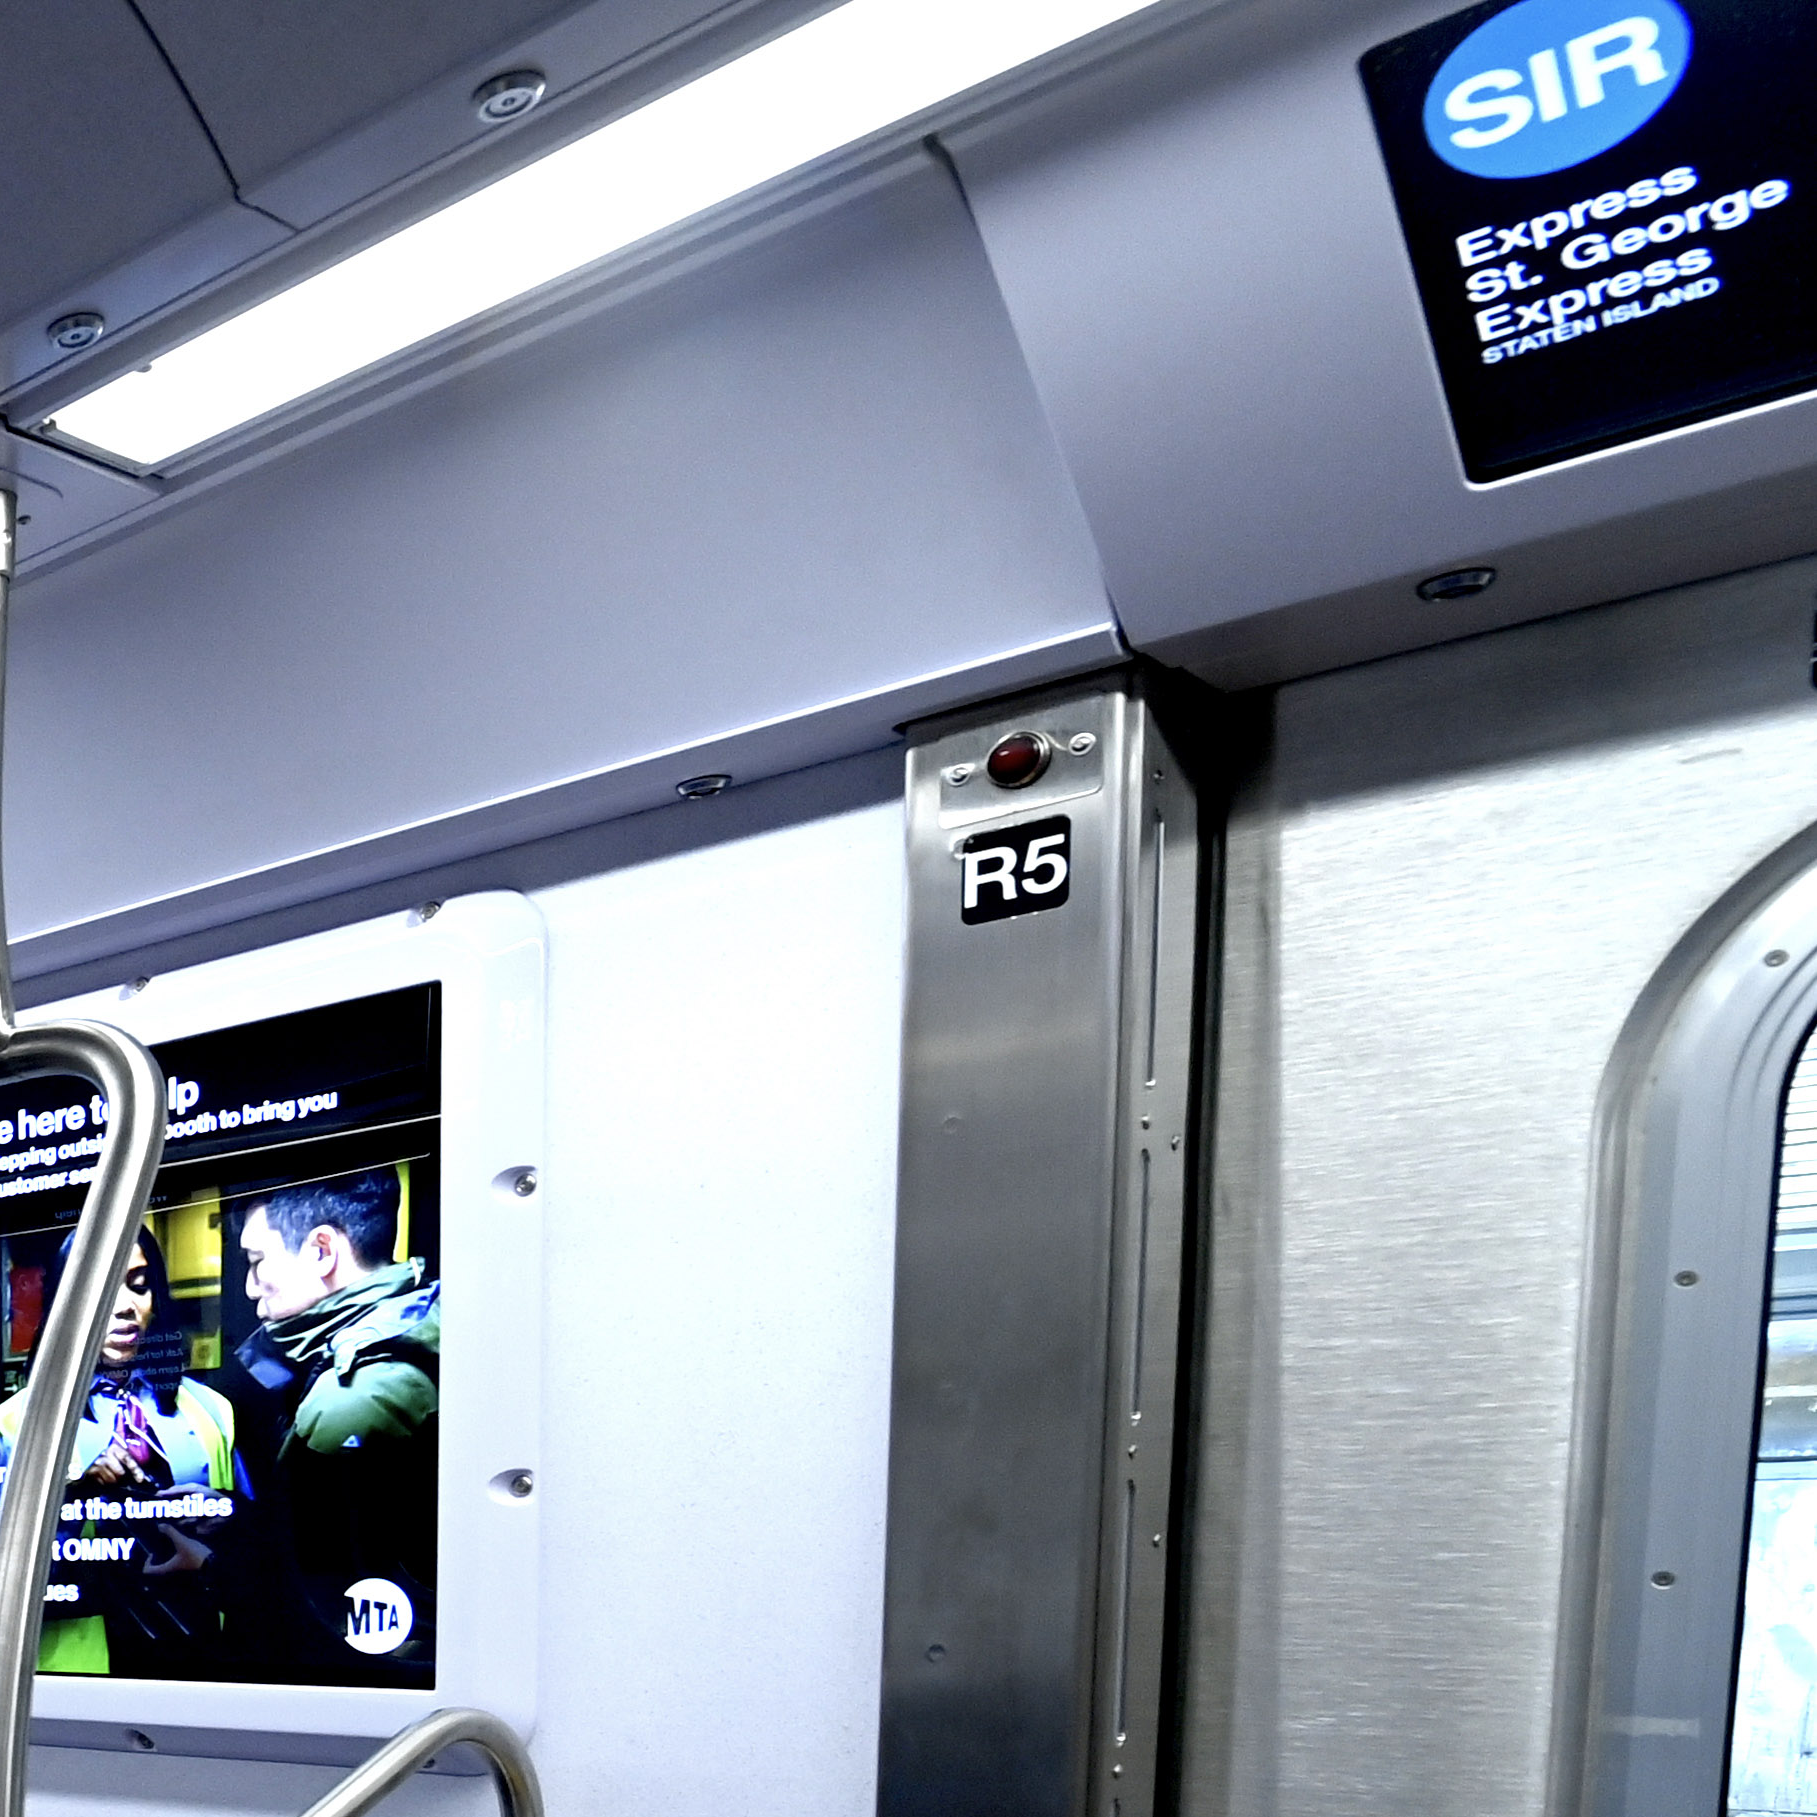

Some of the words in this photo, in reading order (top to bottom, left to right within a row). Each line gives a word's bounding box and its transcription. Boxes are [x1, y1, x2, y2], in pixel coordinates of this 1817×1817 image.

[1444, 16, 1669, 148] SIR
[1456, 166, 1697, 267] Express
[1466, 260, 1544, 302] St.
[1562, 179, 1791, 271] George
[1474, 247, 1714, 343] Express
[1481, 316, 1597, 364] STATEN
[1603, 276, 1722, 327] ISLAND
[962, 834, 1067, 909] R5
[18, 1105, 85, 1140] here
[168, 1076, 200, 1115] lp
[58, 1133, 106, 1159] outsi
[219, 1109, 241, 1129] to
[242, 1100, 296, 1121] bring
[297, 1092, 338, 1118] you
[61, 1499, 83, 1521] at
[85, 1497, 122, 1519] the
[124, 1493, 233, 1518] turnstiles
[63, 1538, 135, 1561] OMNY
[344, 1594, 400, 1637] MTA
